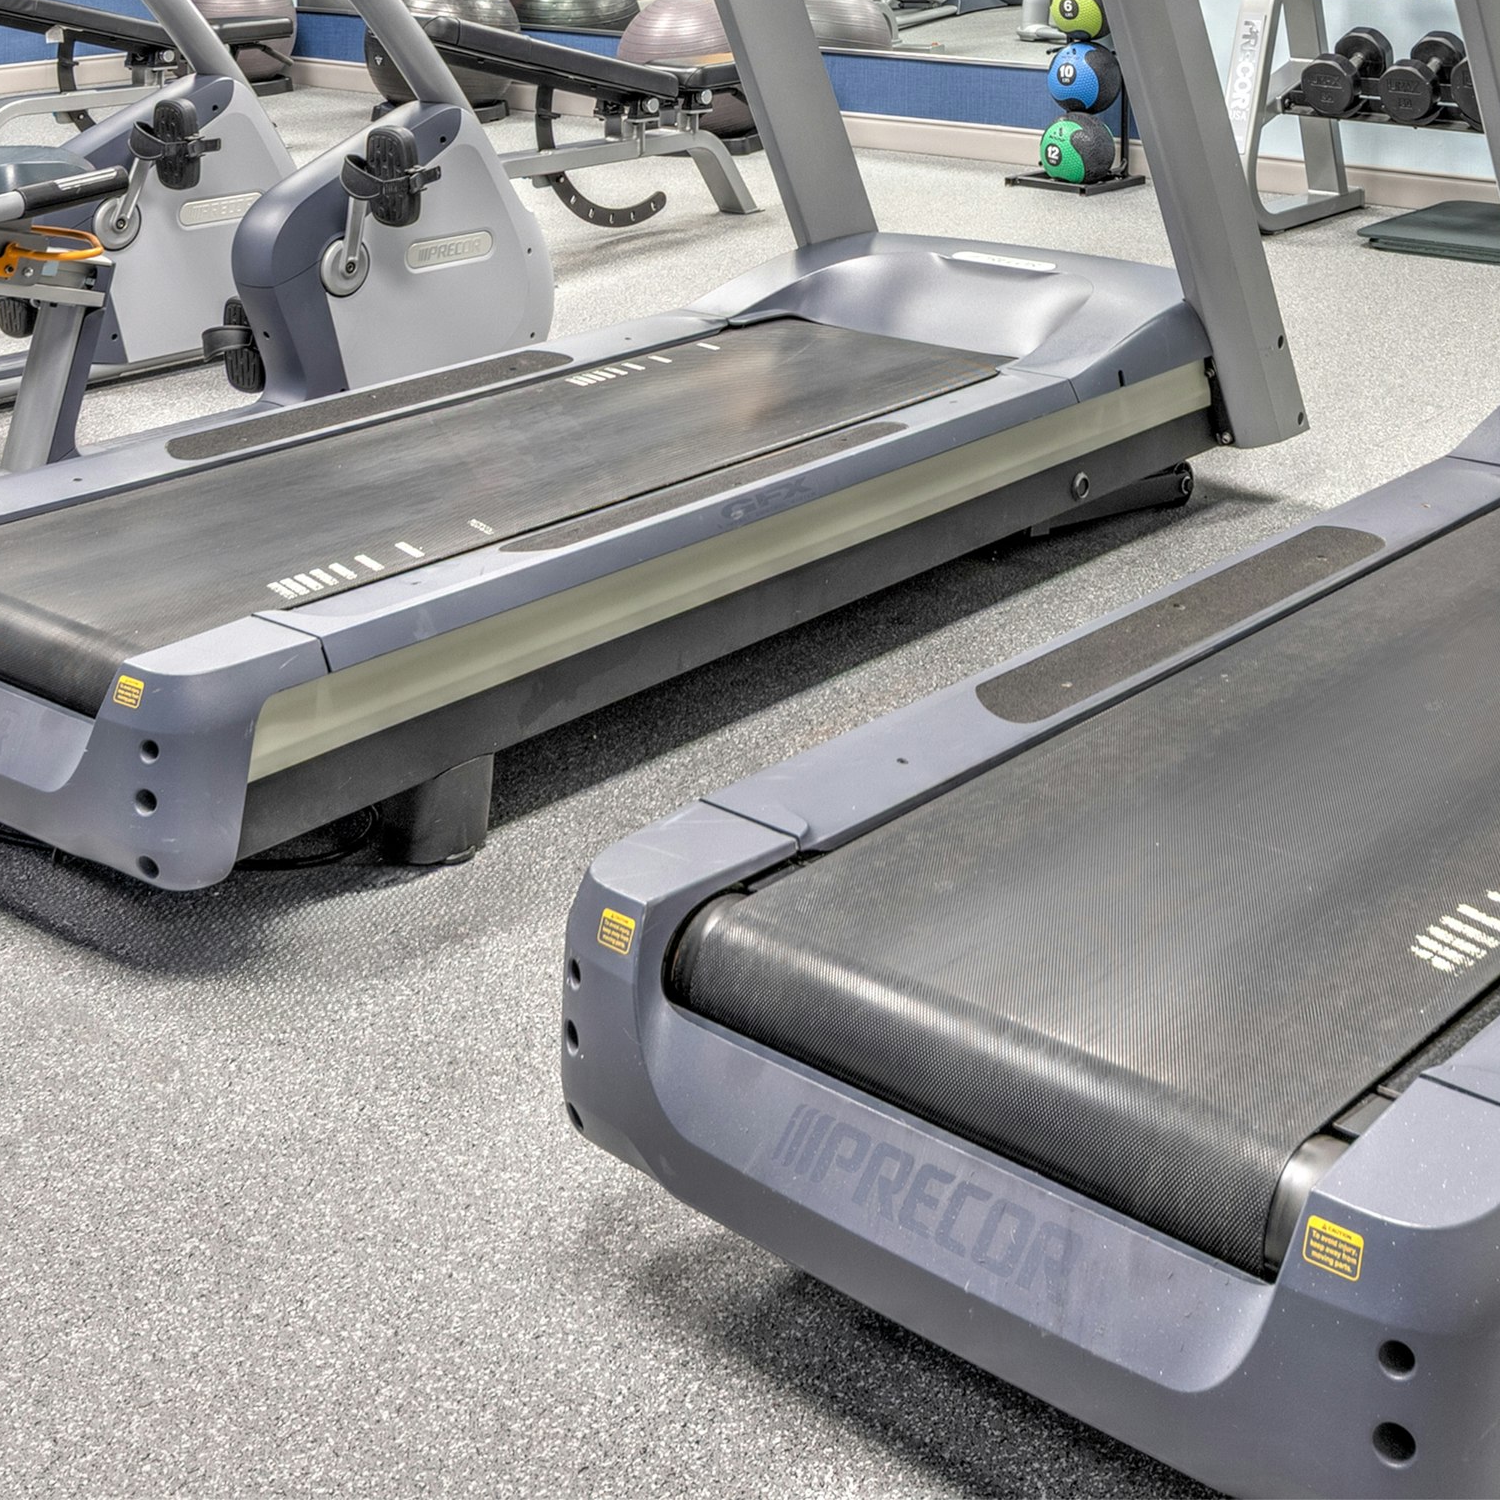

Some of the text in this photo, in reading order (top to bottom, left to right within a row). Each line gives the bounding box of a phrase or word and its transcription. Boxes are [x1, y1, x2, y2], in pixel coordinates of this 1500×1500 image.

[1064, 0, 1072, 12] 6
[1060, 65, 1074, 78] 10
[1048, 146, 1060, 160] 12
[428, 237, 481, 261] PRECOR
[809, 1121, 1084, 1300] PRECOR
[1310, 1239, 1357, 1265] keep away from
[1312, 1230, 1358, 1257] To avoid injury,
[1311, 1250, 1353, 1273] moving parts.
